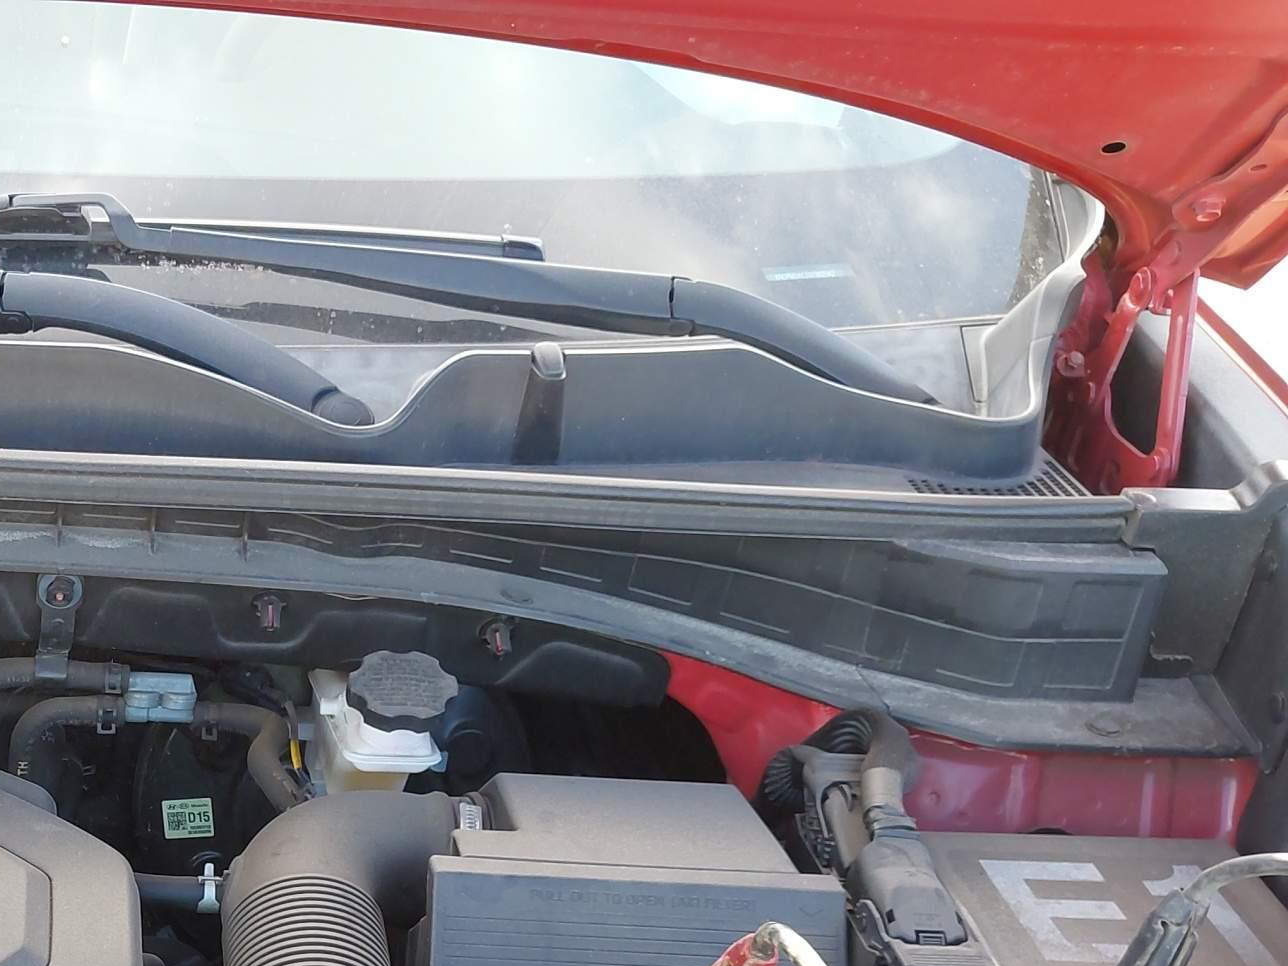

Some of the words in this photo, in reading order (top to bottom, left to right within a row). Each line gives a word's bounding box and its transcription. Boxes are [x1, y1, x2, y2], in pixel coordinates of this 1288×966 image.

[187, 811, 210, 823] D15
[603, 893, 623, 905] TO
[979, 859, 1280, 966] E1
